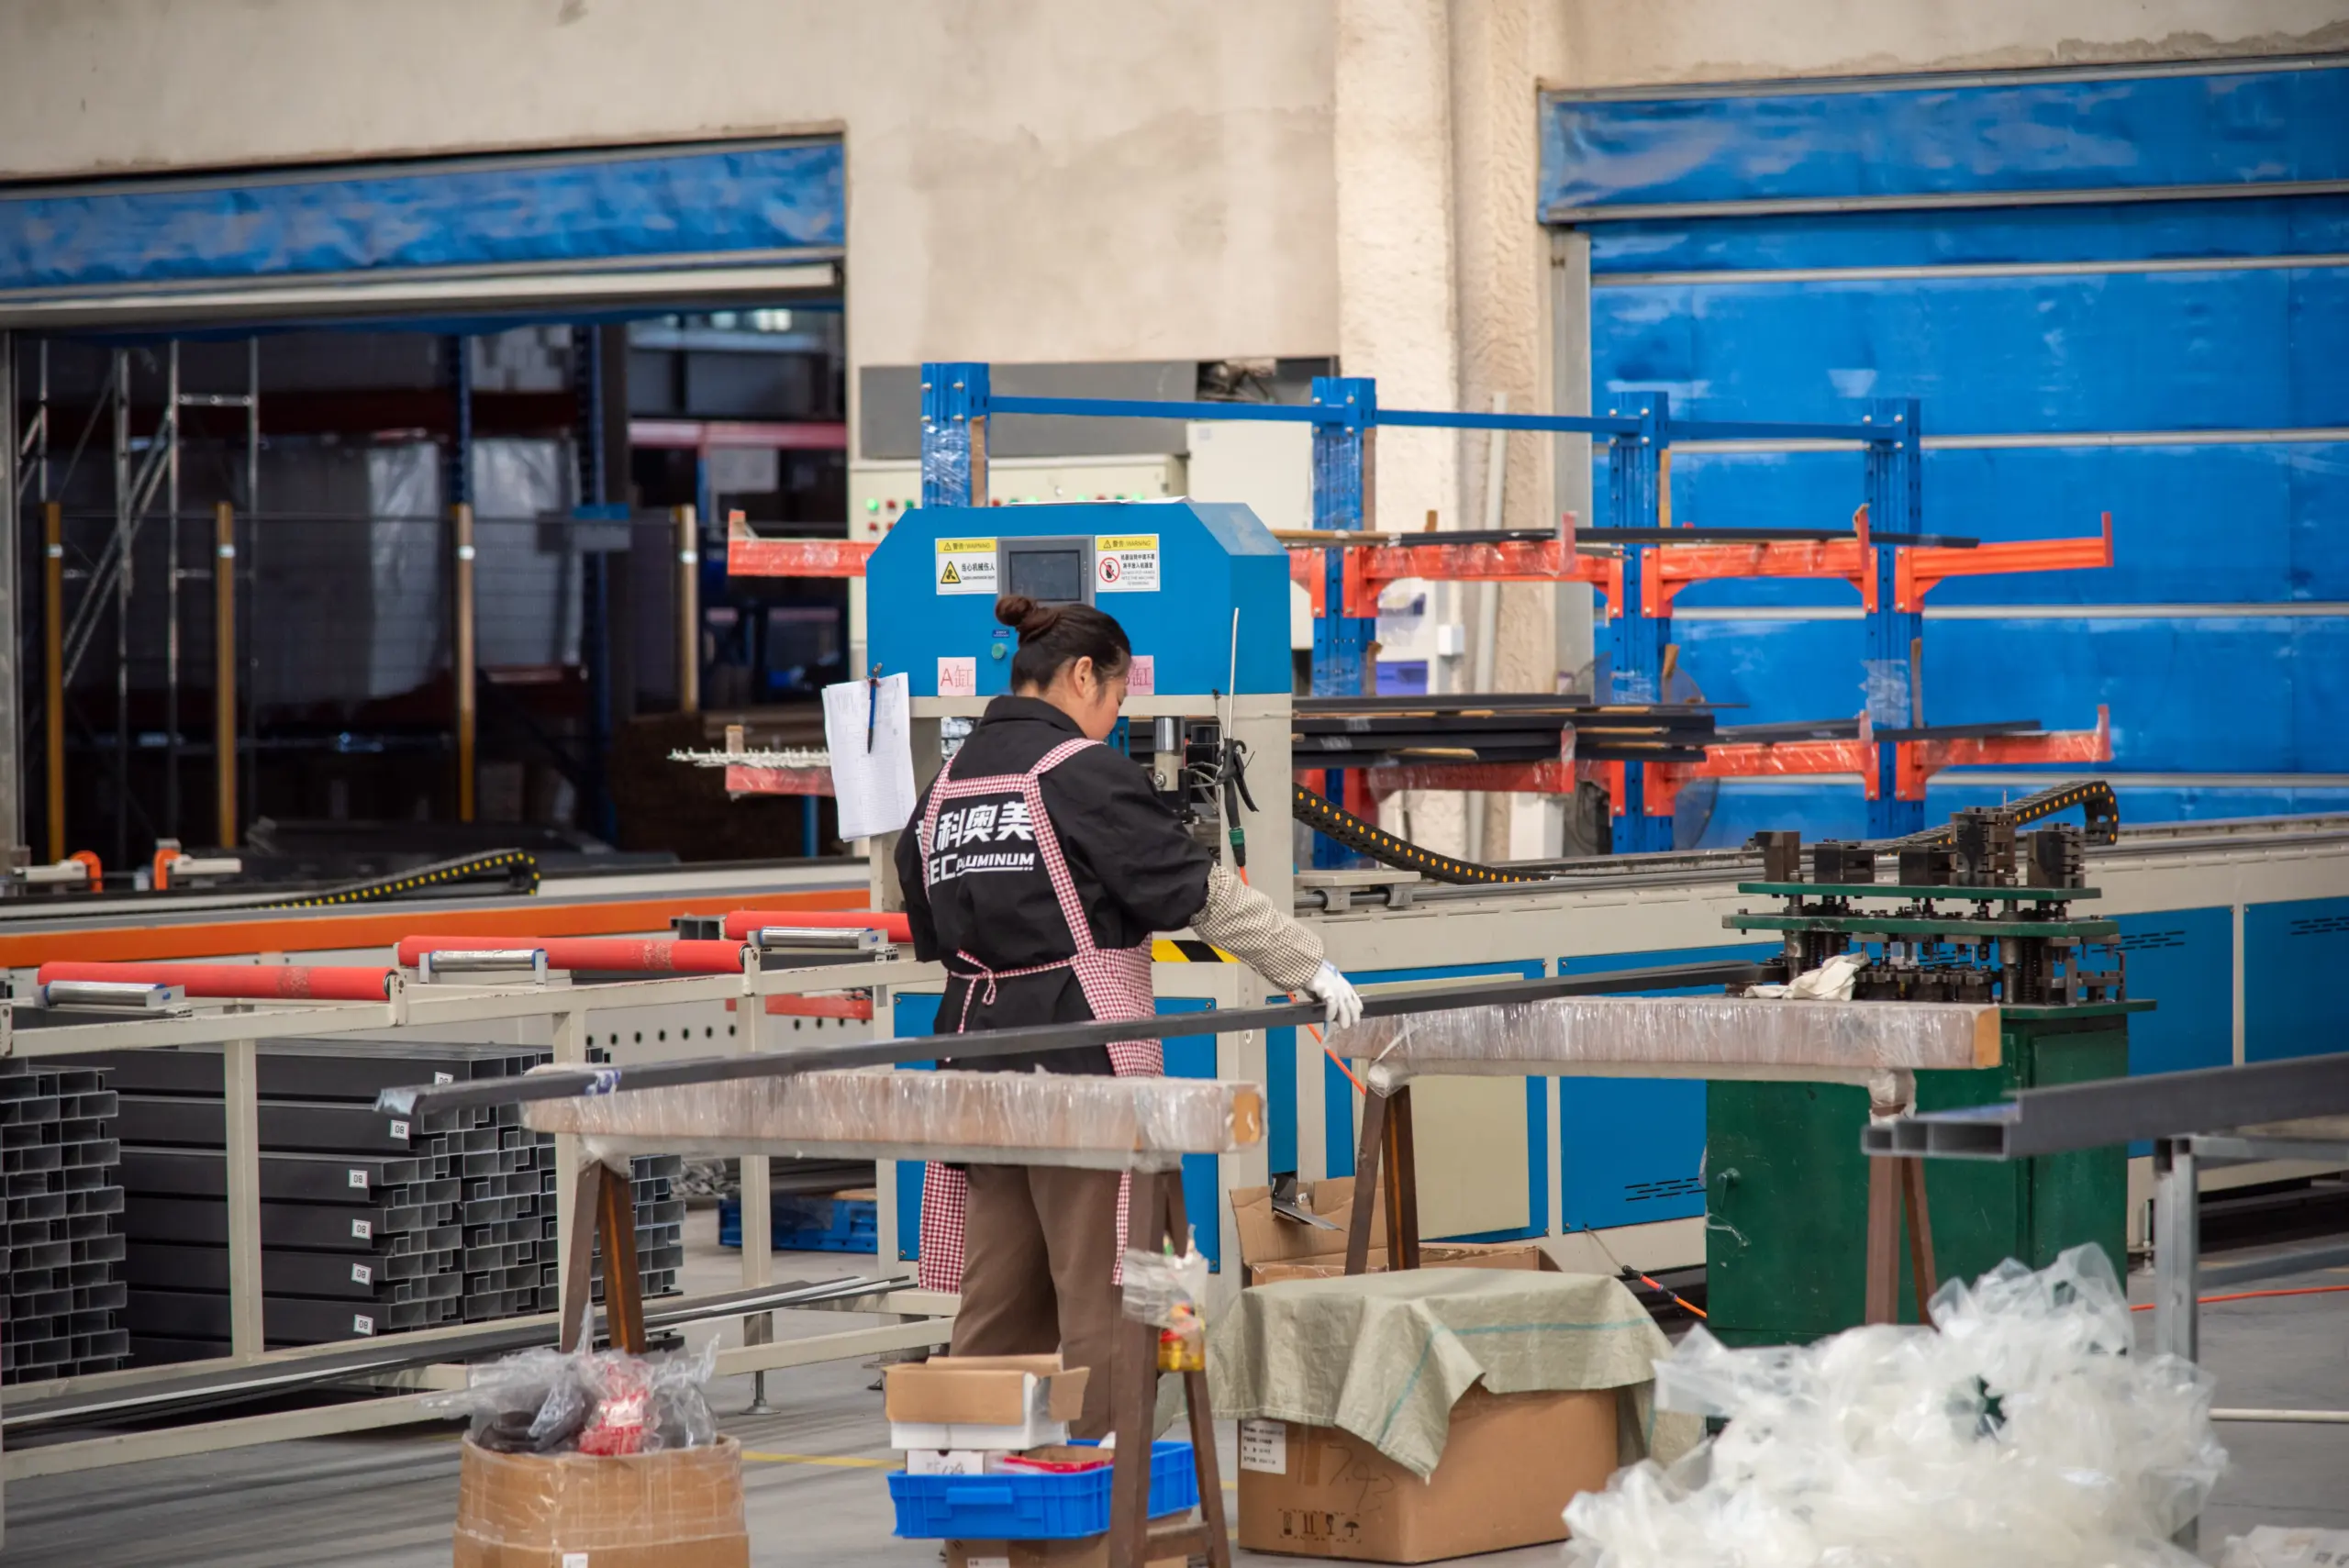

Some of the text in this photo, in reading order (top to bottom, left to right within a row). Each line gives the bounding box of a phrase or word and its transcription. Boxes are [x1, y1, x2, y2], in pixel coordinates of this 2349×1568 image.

[940, 664, 974, 688] A缸
[395, 1125, 405, 1135] 08
[353, 1174, 363, 1184] 08
[356, 1224, 367, 1234] 08
